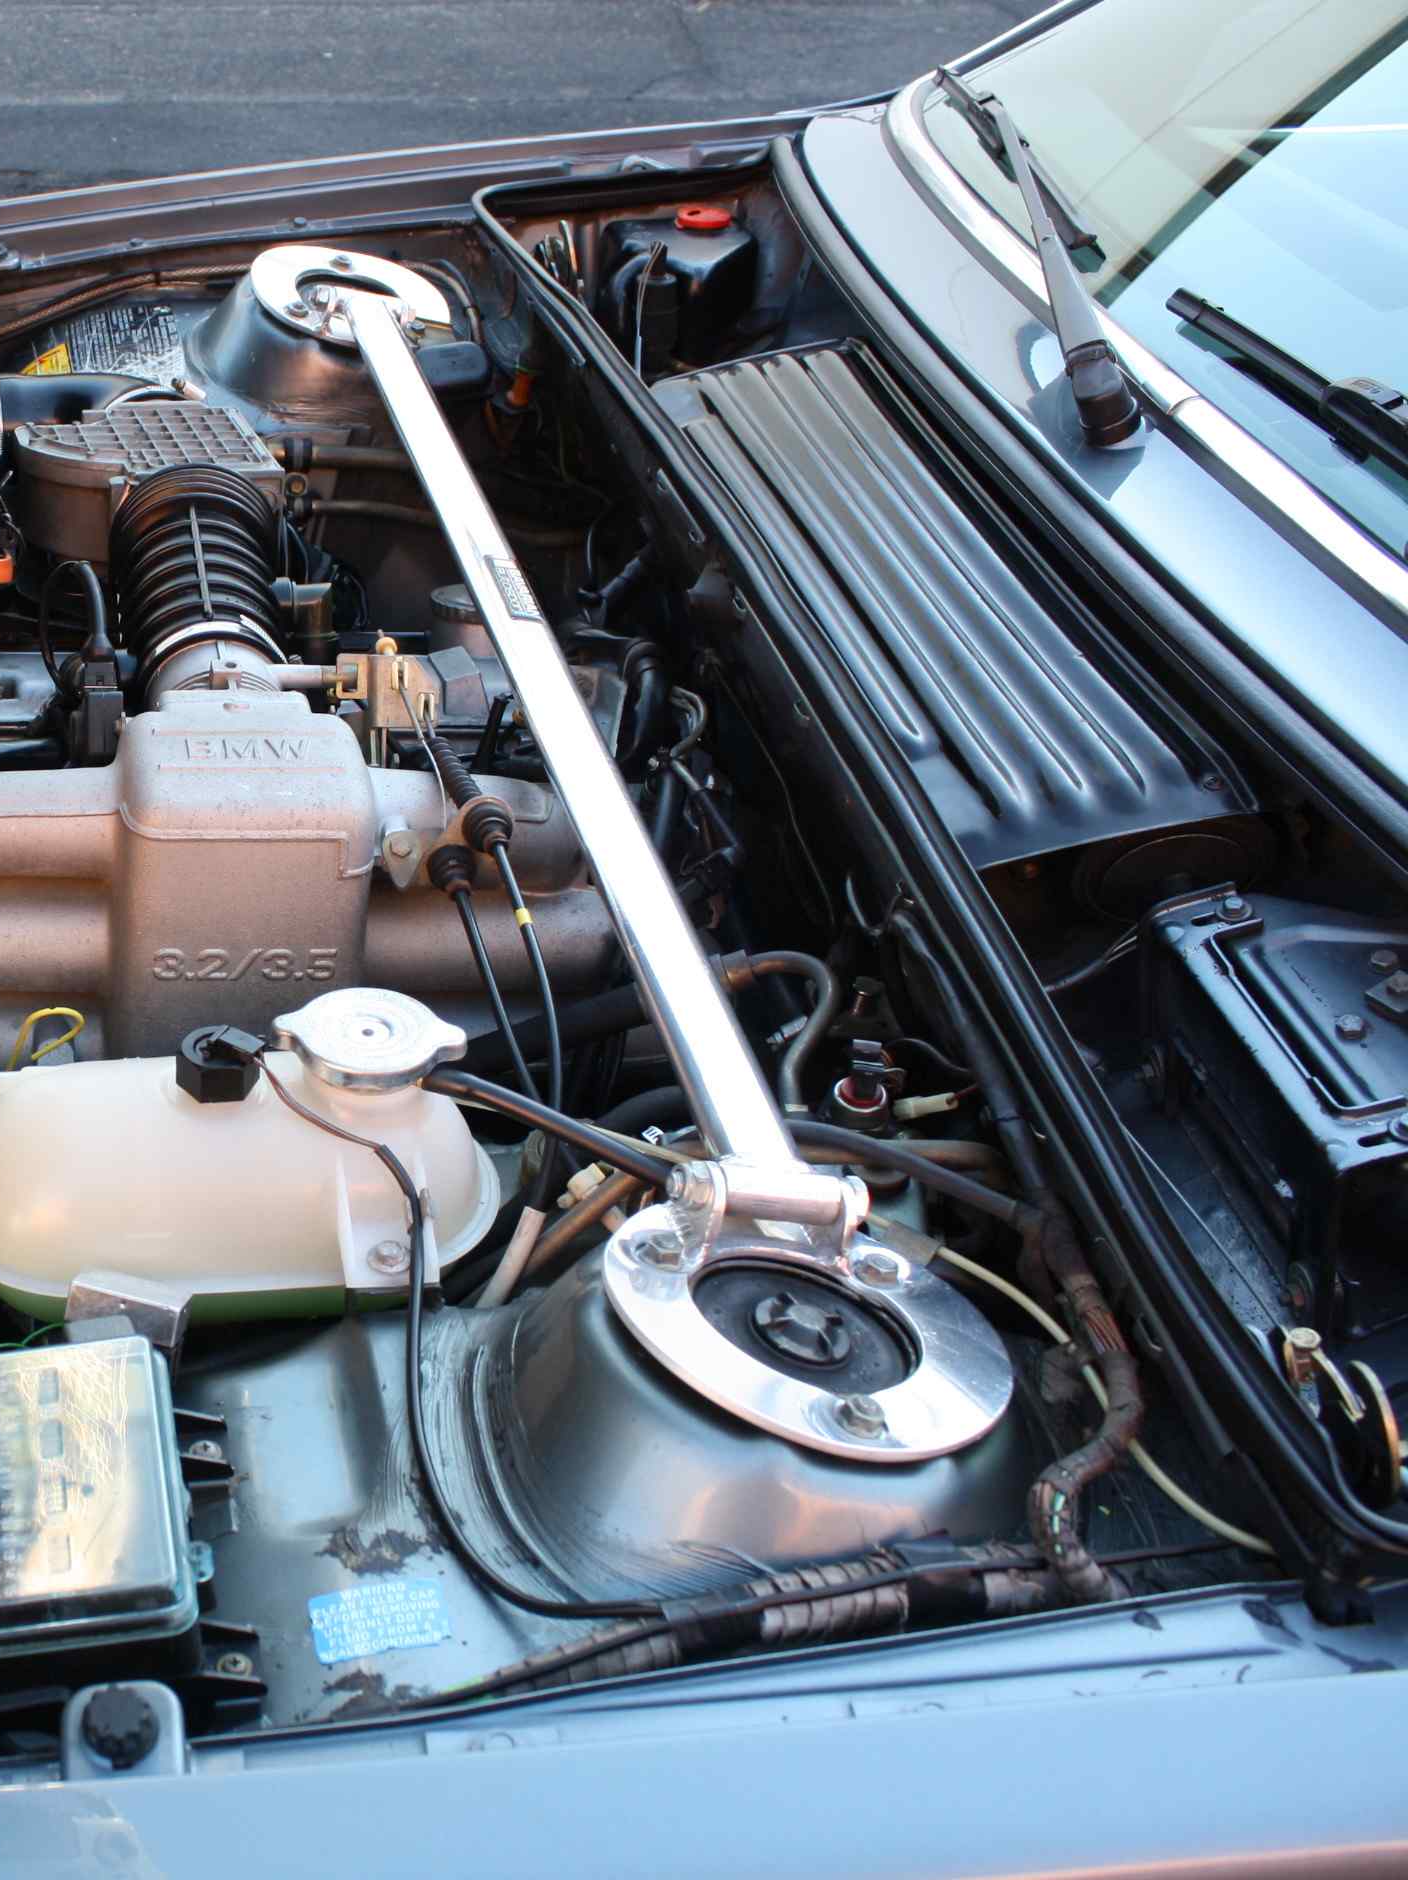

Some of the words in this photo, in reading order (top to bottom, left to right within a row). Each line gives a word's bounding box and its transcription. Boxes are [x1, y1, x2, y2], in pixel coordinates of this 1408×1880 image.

[184, 738, 311, 760] BMW
[152, 947, 338, 981] 3.2/3.5
[340, 1582, 406, 1601] WARNING
[409, 1588, 436, 1601] CAP
[372, 1600, 441, 1617] REMOVING
[395, 1611, 422, 1625] DOT
